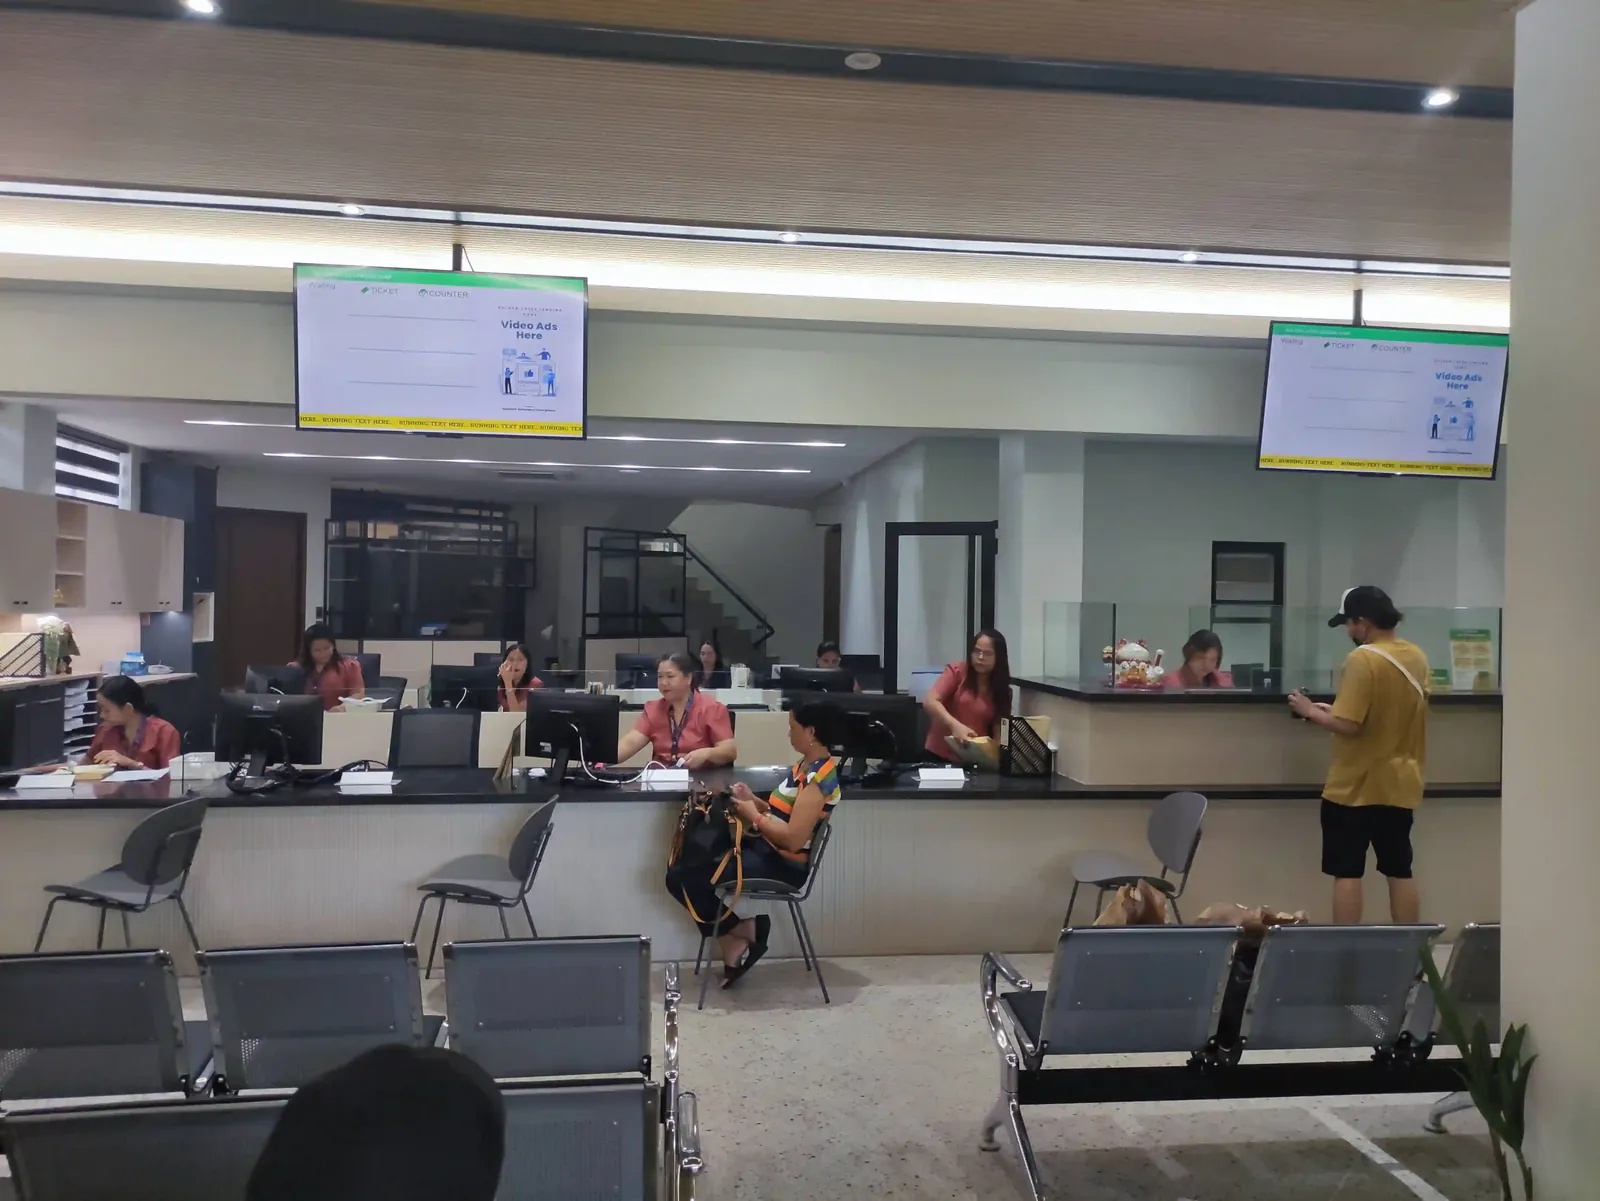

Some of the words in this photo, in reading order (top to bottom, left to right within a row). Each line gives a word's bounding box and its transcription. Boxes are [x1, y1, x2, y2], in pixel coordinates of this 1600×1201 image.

[371, 286, 399, 295] TICKET
[428, 290, 469, 298] COUNTER
[500, 320, 534, 330] Video
[535, 322, 558, 331] Ads
[516, 331, 543, 340] Here
[1378, 344, 1412, 352] COUNTER
[1435, 371, 1463, 381] Video
[1464, 373, 1483, 382] Ads
[1446, 381, 1469, 390] Here
